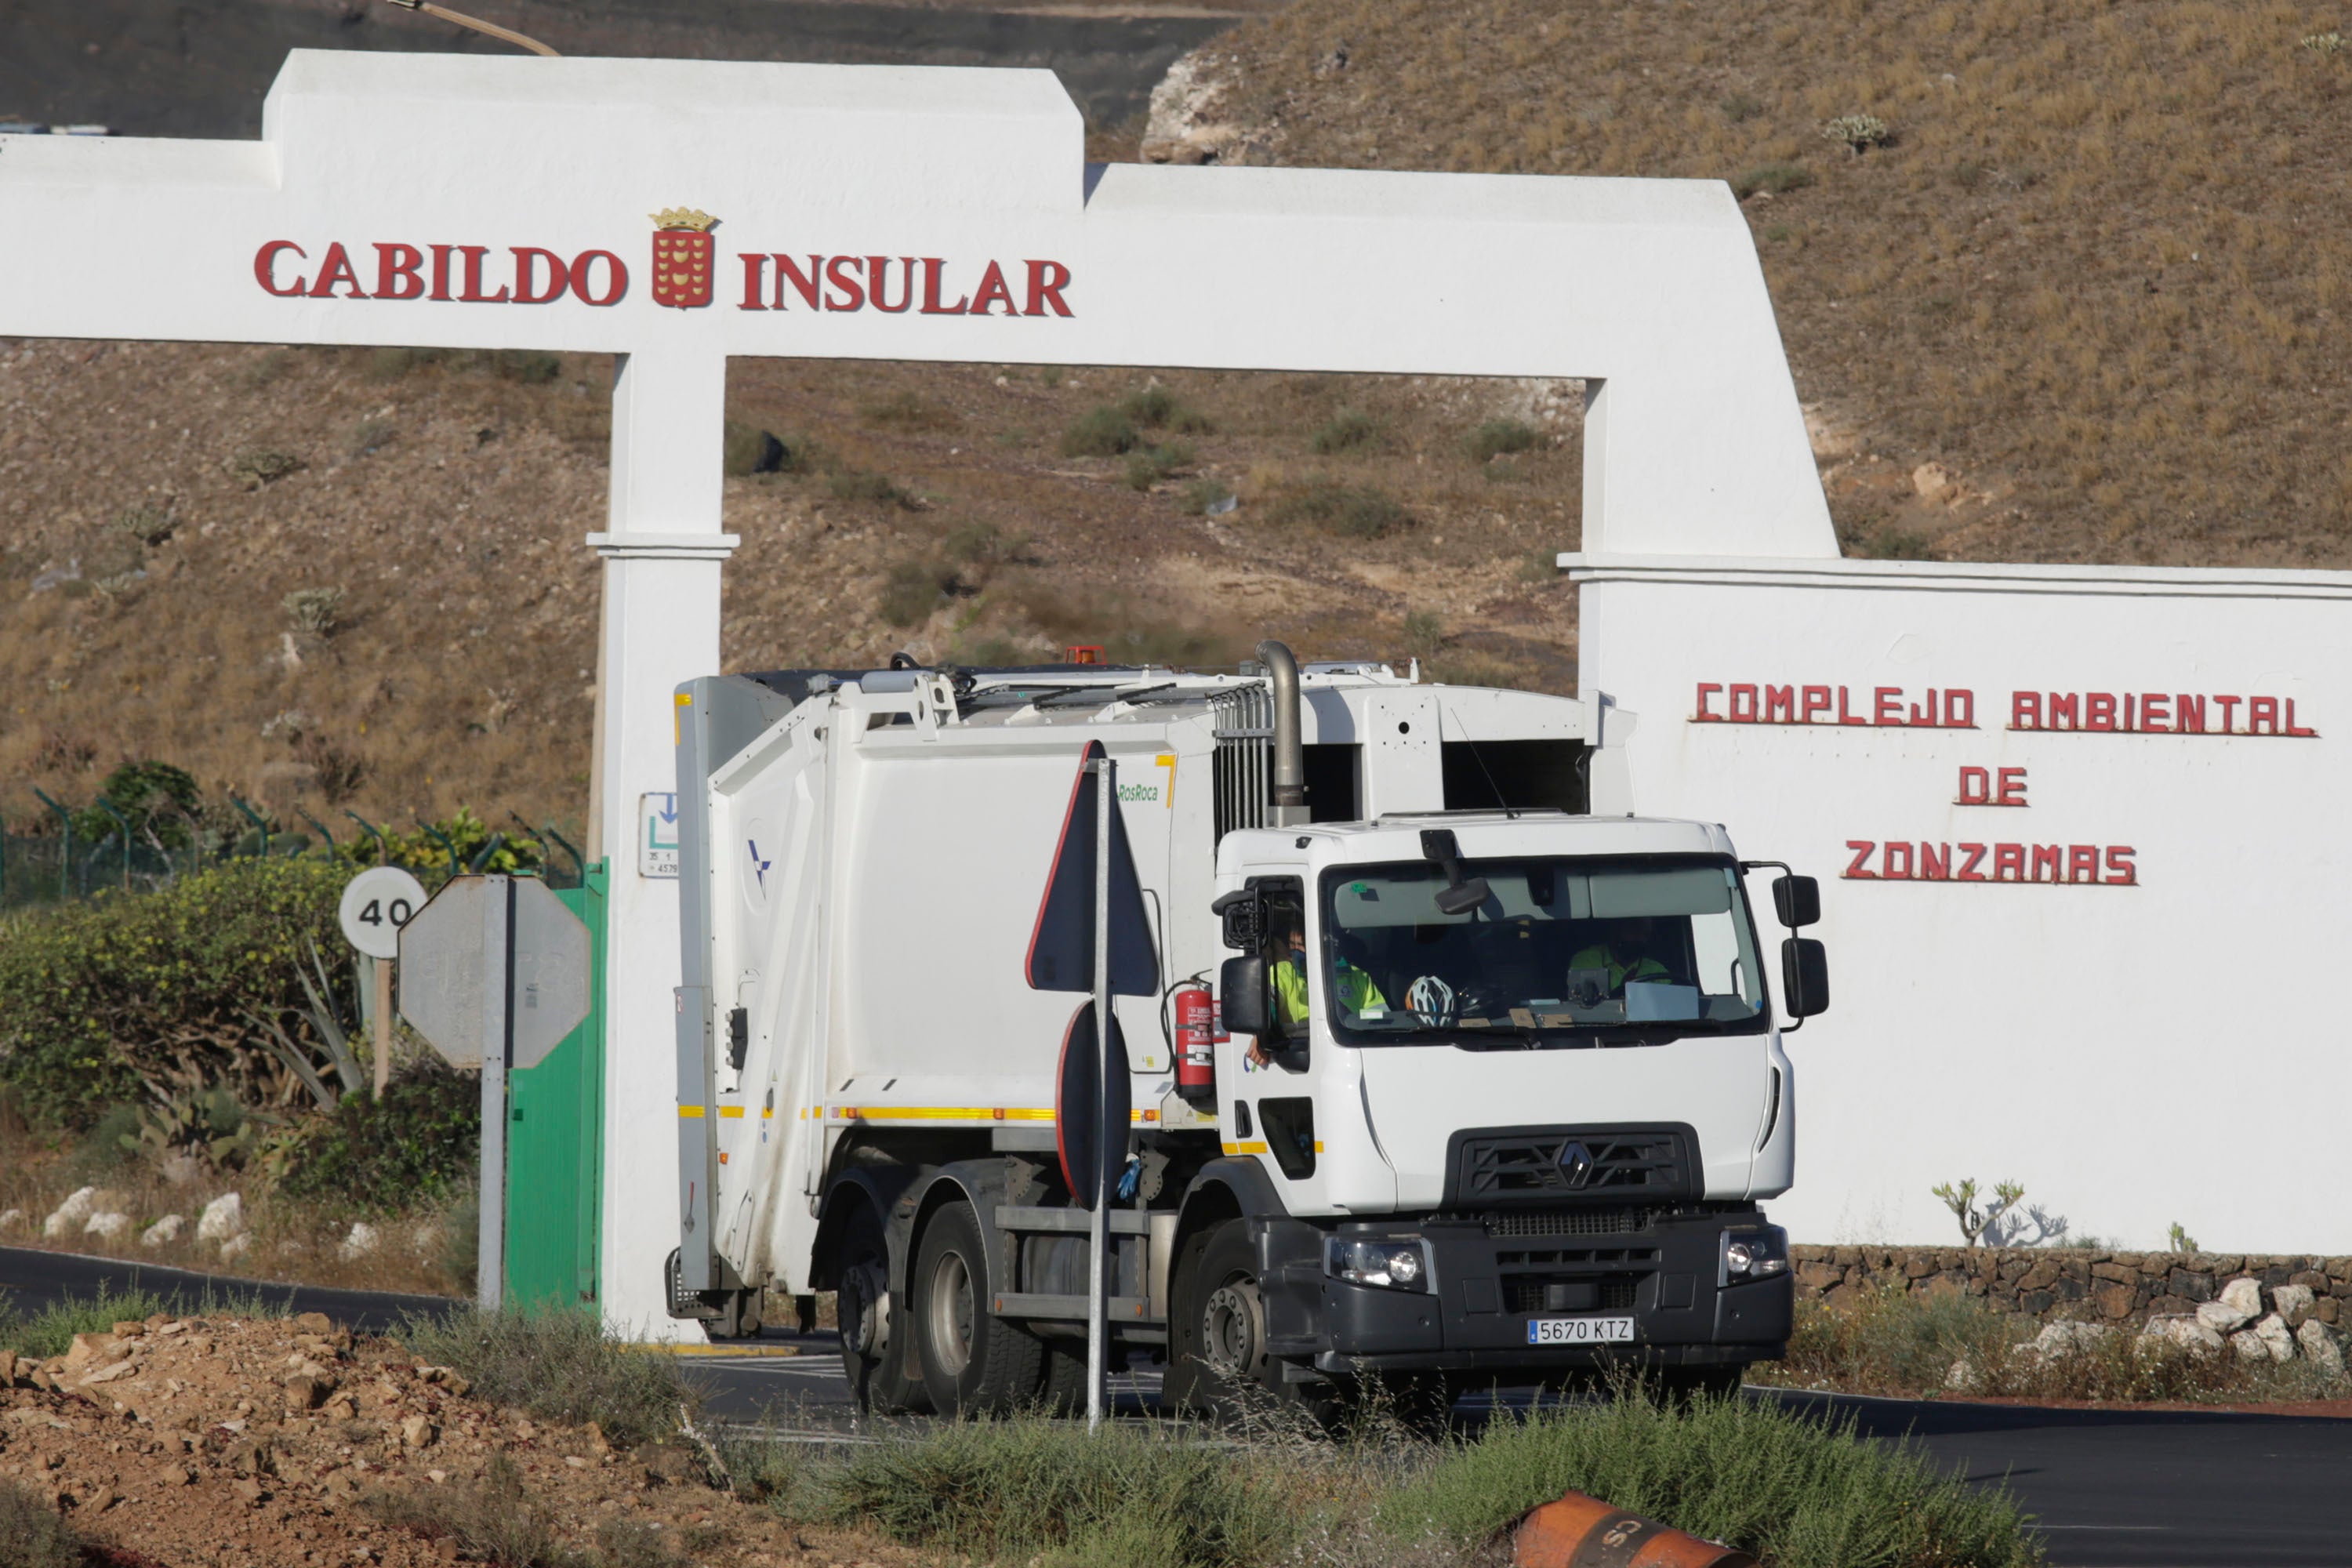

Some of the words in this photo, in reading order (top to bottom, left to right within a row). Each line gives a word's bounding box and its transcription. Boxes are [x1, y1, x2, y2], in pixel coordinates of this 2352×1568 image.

[254, 240, 627, 306] CABILDO
[738, 253, 1073, 317] INSULAR
[1697, 683, 1974, 728] COMPLEJO
[2012, 691, 2315, 736] AMBIENTAL
[1117, 784, 1158, 801] RosRoca
[1960, 766, 2027, 805] DE
[1846, 840, 2136, 884] ZONZAMAS
[359, 898, 412, 927] 40
[1541, 1322, 1587, 1340] 5670
[1594, 1321, 1628, 1339] KTZ
